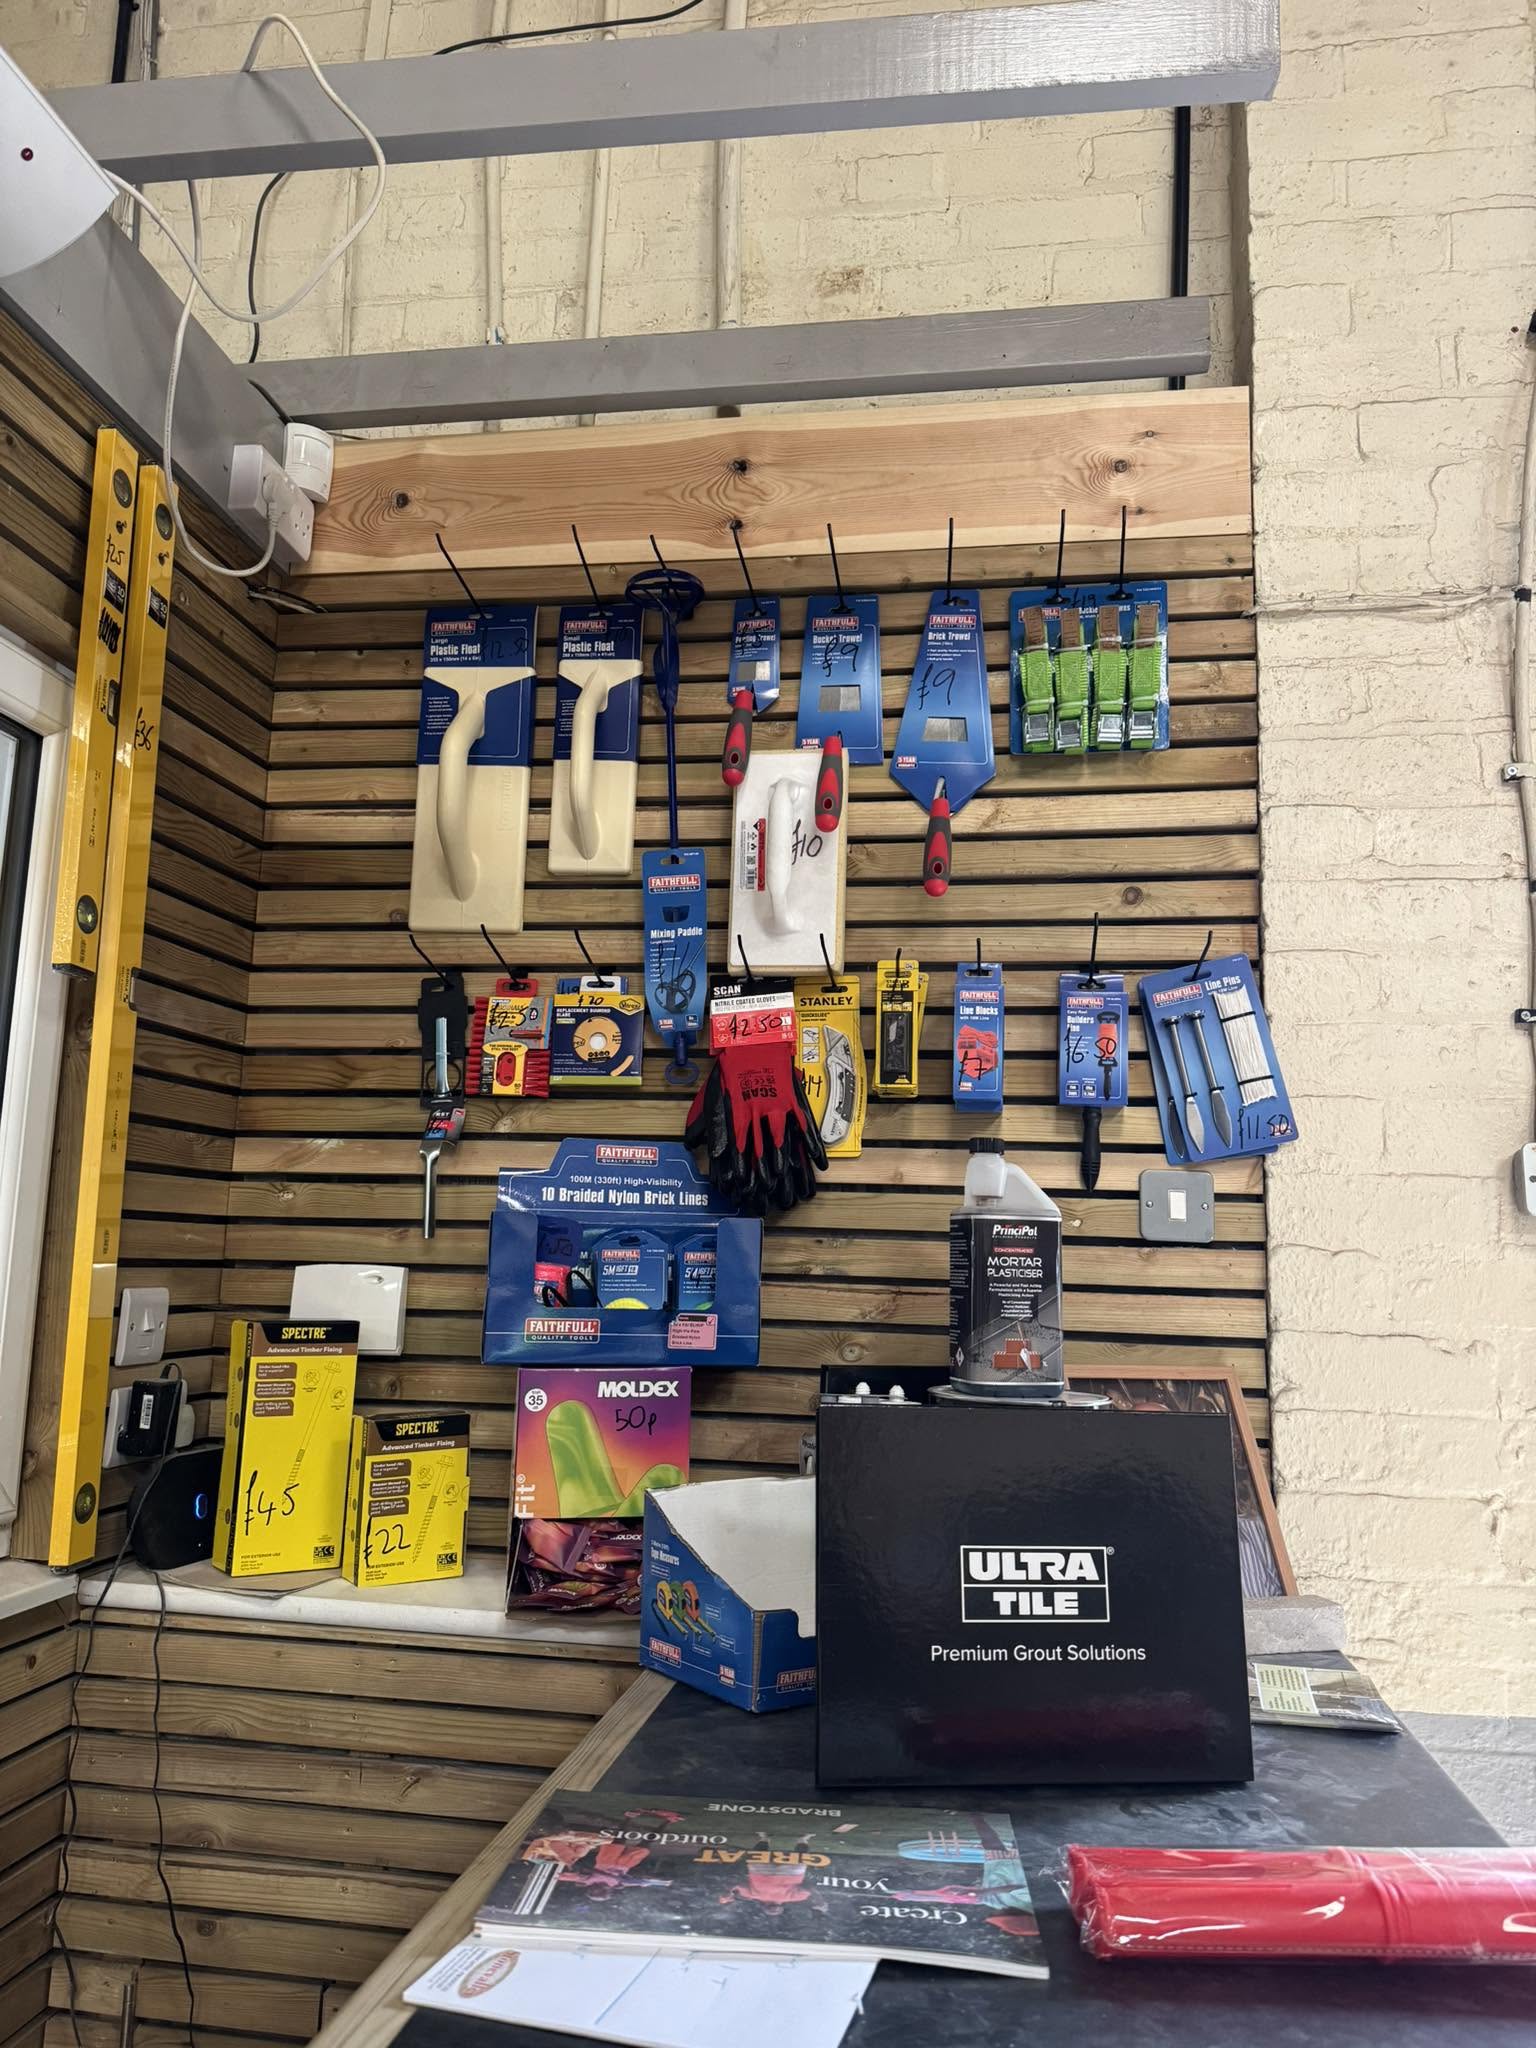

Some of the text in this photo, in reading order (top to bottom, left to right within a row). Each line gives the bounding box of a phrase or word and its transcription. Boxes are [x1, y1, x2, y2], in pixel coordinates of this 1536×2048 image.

[432, 622, 473, 631] FAITHFULL
[566, 621, 605, 630] FAITHFULL
[815, 617, 856, 626] FAITHFULL
[932, 615, 973, 625] FAITHFULL
[812, 633, 863, 644] Bucket Trowel
[927, 631, 971, 641] Brick Trowel
[430, 643, 481, 656] Plastic Float
[563, 640, 615, 653] Plastic Float
[822, 638, 860, 678] £9
[917, 663, 957, 710] £9
[792, 818, 823, 865] £10
[651, 876, 698, 888] FAITHFULL
[650, 926, 703, 939] Mixing Paddle
[1204, 975, 1241, 991] Line Pins
[713, 985, 742, 997] SCAN
[961, 991, 997, 999] FAITHFULL
[1155, 984, 1201, 1002] FAITHFULL
[756, 995, 777, 1003] GLOVES
[800, 996, 853, 1007] STANLEY
[1069, 997, 1102, 1005] FAITHFULL
[960, 1005, 999, 1015] Line Blocks
[1067, 1015, 1095, 1024] Builders
[1064, 1027, 1117, 1073] £6.50
[599, 1147, 653, 1159] FAITHFULL
[570, 1175, 683, 1189] 100M (330ft) High-Visibility
[541, 1187, 709, 1206] 10 Braided Nylon Brick Lines
[992, 1224, 1038, 1237] PrinciPal
[604, 1250, 638, 1258] FAITHFULL
[987, 1256, 1042, 1267] MORTAR
[987, 1267, 1043, 1278] PLASTICISER
[530, 1320, 595, 1333] FAITHFULL
[281, 1327, 327, 1340] SPECTRE
[323, 1346, 343, 1354] Fixing
[597, 1380, 679, 1398] MOLDEX
[528, 1395, 544, 1406] 35
[615, 1405, 657, 1436] 50p
[395, 1421, 440, 1436] SPECTRE
[382, 1443, 414, 1451] Advanced
[244, 1470, 300, 1536] £45
[363, 1514, 411, 1568] £22
[968, 1551, 1100, 1581] ULTRA
[993, 1591, 1080, 1616] TILE
[651, 1639, 680, 1659] FAITHFULL
[931, 1644, 1147, 1662] Premium Grout Solutions
[780, 1669, 816, 1684] FAITHFU
[708, 1803, 842, 1818] BRADSTONE
[599, 1829, 728, 1846] outdoors
[693, 1849, 832, 1868] GREAT
[816, 1875, 890, 1892] your
[859, 1904, 968, 1926] Create
